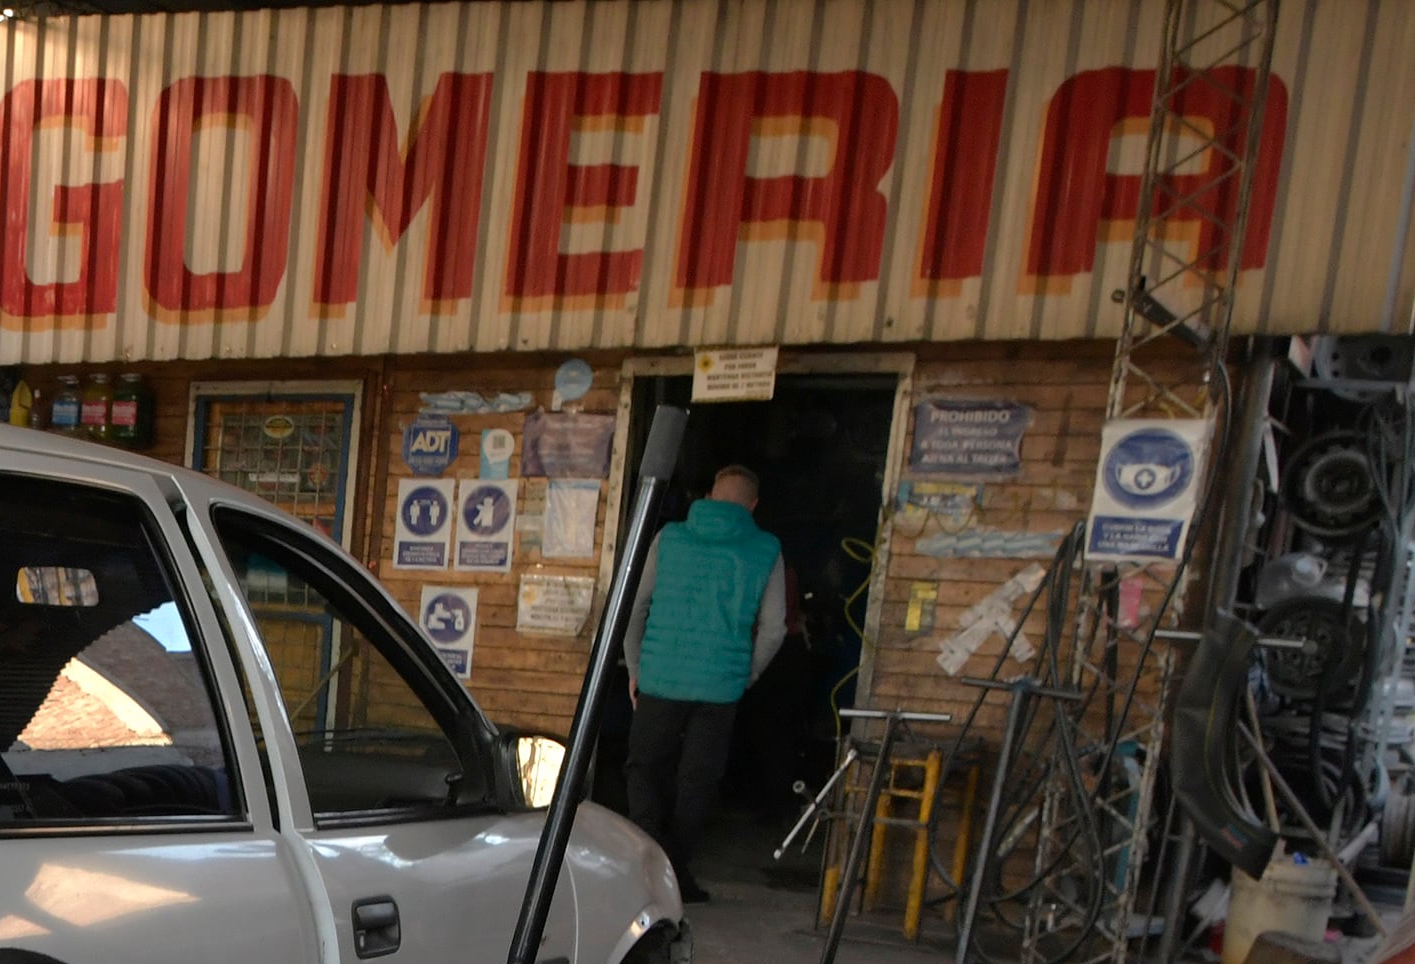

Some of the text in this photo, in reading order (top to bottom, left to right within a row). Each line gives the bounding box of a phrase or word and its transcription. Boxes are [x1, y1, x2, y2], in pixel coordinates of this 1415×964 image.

[930, 409, 1011, 422] PROHIBIDO
[411, 430, 451, 453] ADT
[962, 440, 1012, 449] PERSONA
